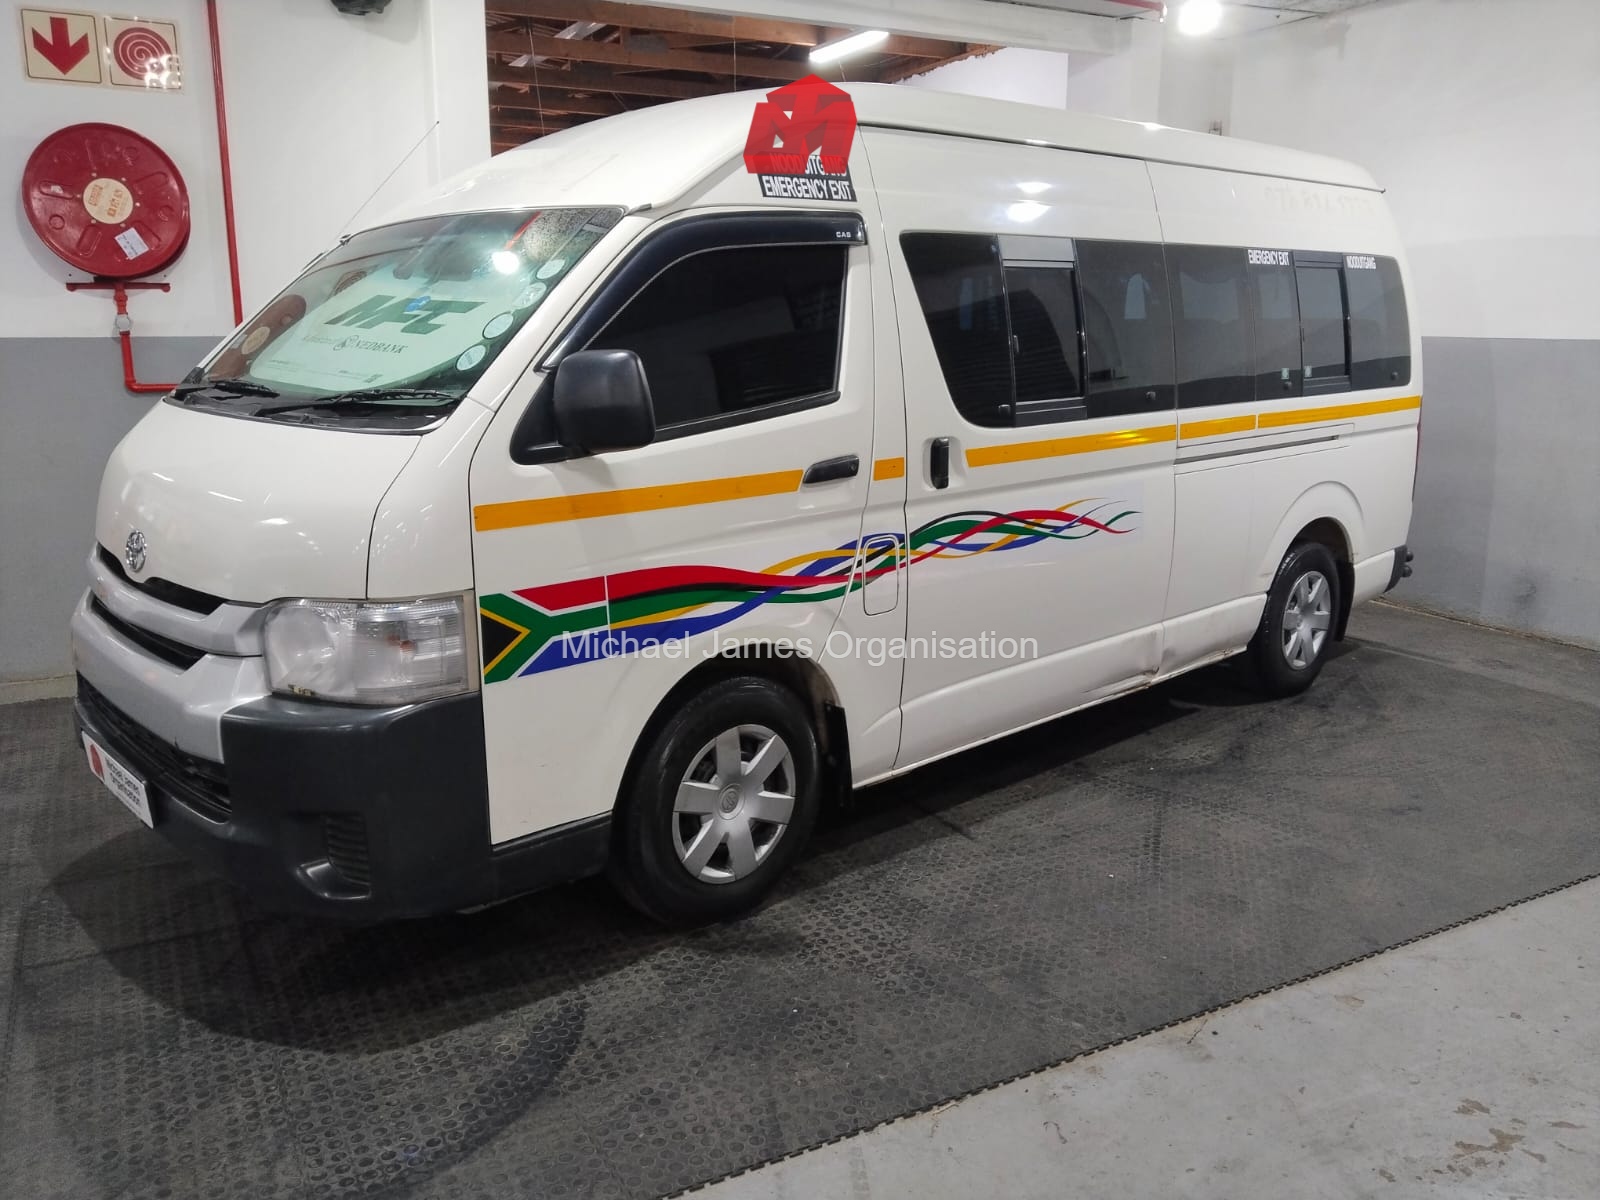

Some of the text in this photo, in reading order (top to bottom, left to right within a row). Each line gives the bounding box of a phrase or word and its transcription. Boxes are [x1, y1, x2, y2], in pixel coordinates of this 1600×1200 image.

[762, 176, 852, 200] EMERGENCY EXIT
[1248, 249, 1278, 265] EMERGENCY
[352, 339, 408, 353] NEDBANK
